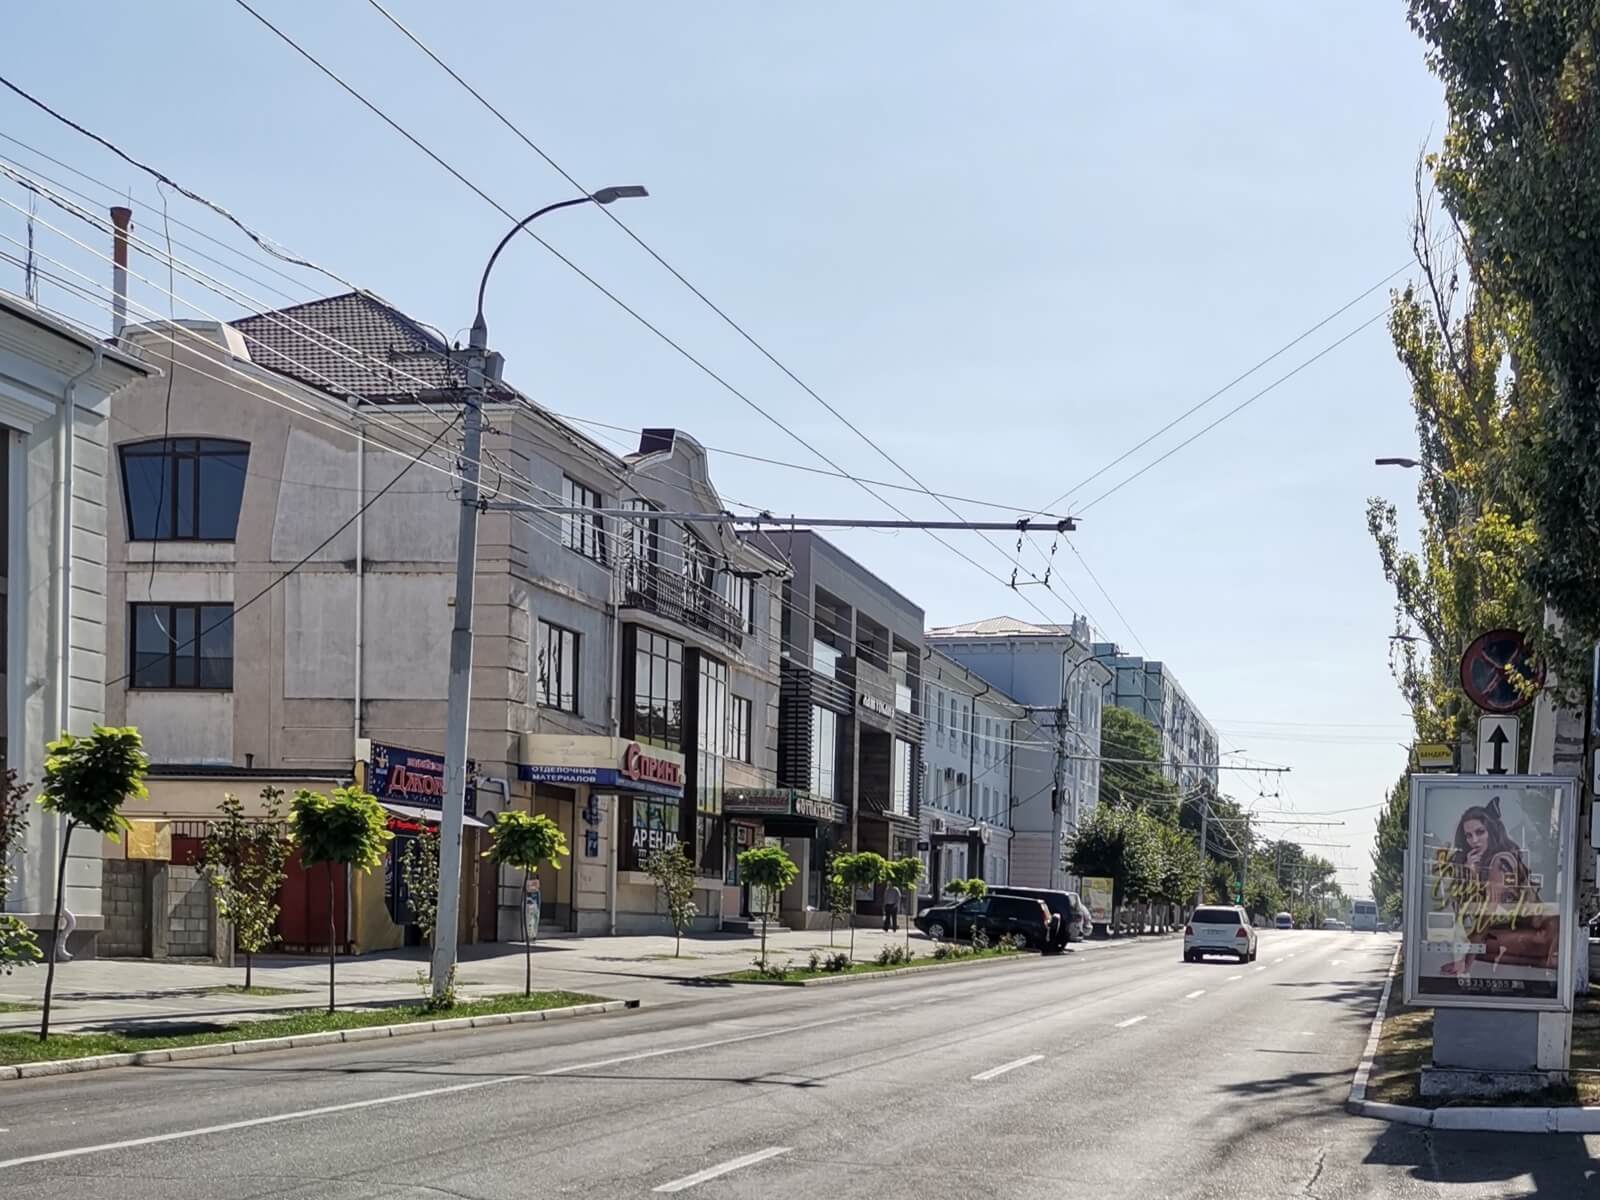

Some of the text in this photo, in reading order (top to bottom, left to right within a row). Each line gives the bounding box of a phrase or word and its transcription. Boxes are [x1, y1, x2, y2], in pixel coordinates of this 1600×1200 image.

[531, 766, 597, 775] ОТДЕЛОЧНЫХ
[531, 774, 597, 783] МАТЕРИАЛОВ
[632, 828, 679, 851] АРЕНДА
